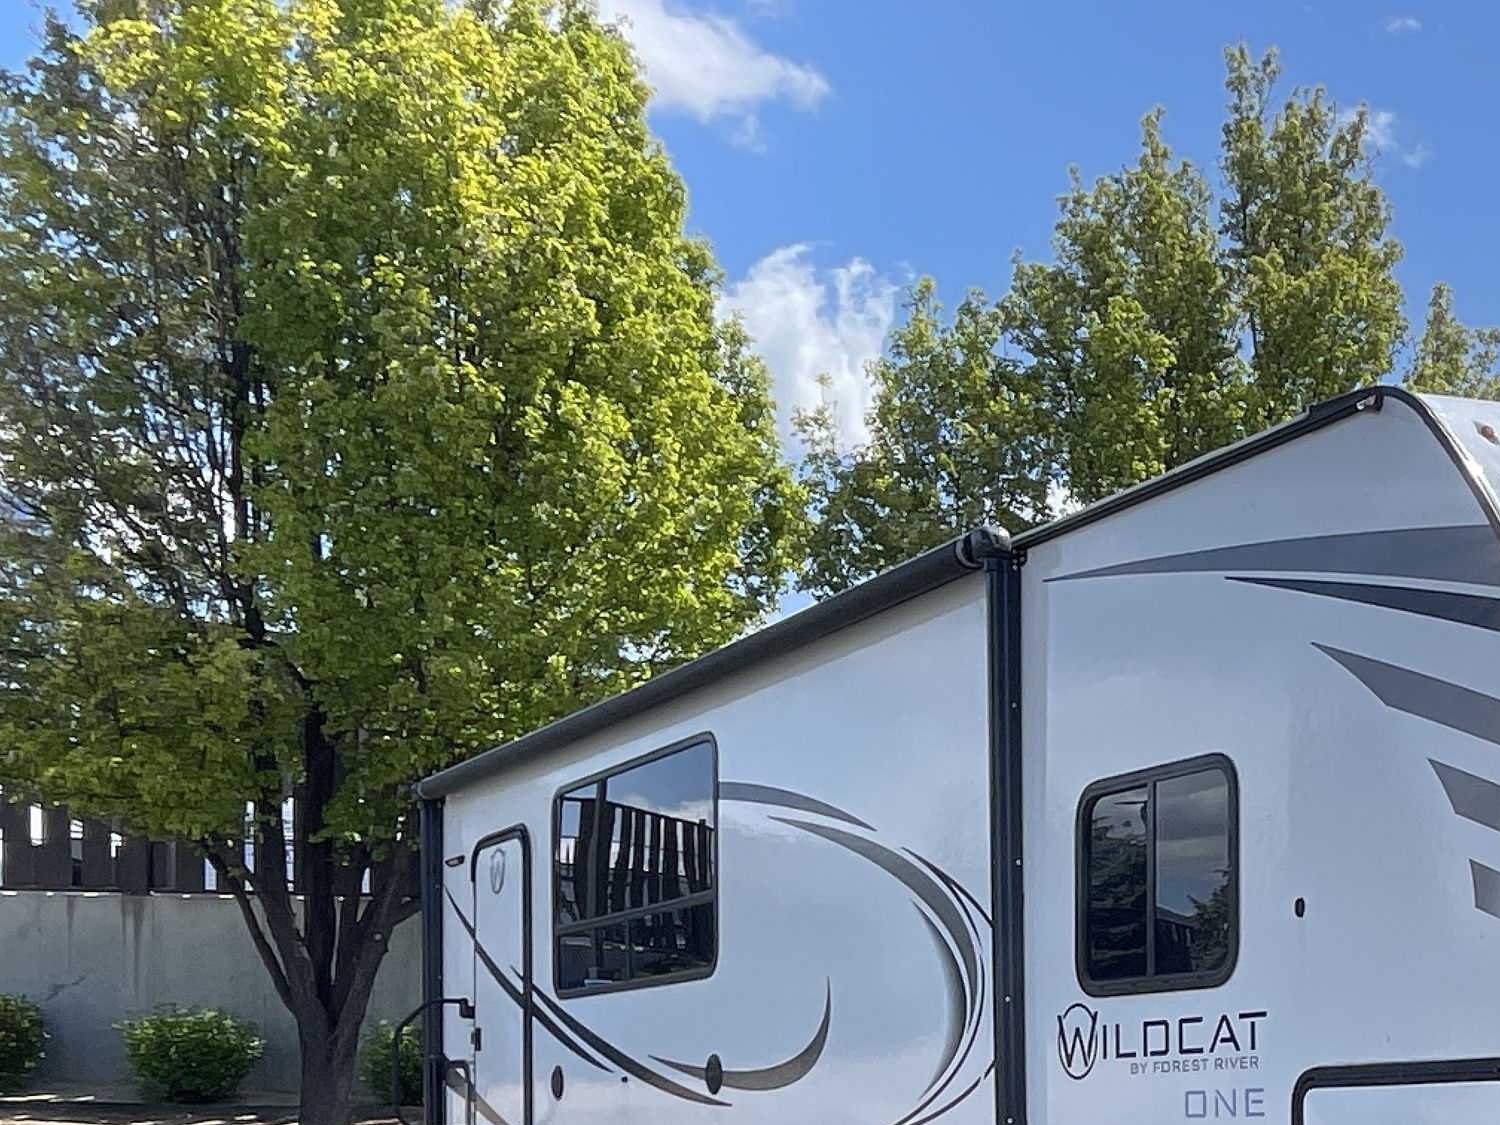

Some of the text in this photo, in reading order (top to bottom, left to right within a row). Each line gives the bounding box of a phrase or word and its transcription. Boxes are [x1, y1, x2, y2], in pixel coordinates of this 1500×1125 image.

[1057, 1003, 1268, 1081] WILDCAT
[1130, 1056, 1260, 1075] BY FOREST RIVER
[1184, 1088, 1266, 1118] ONE
